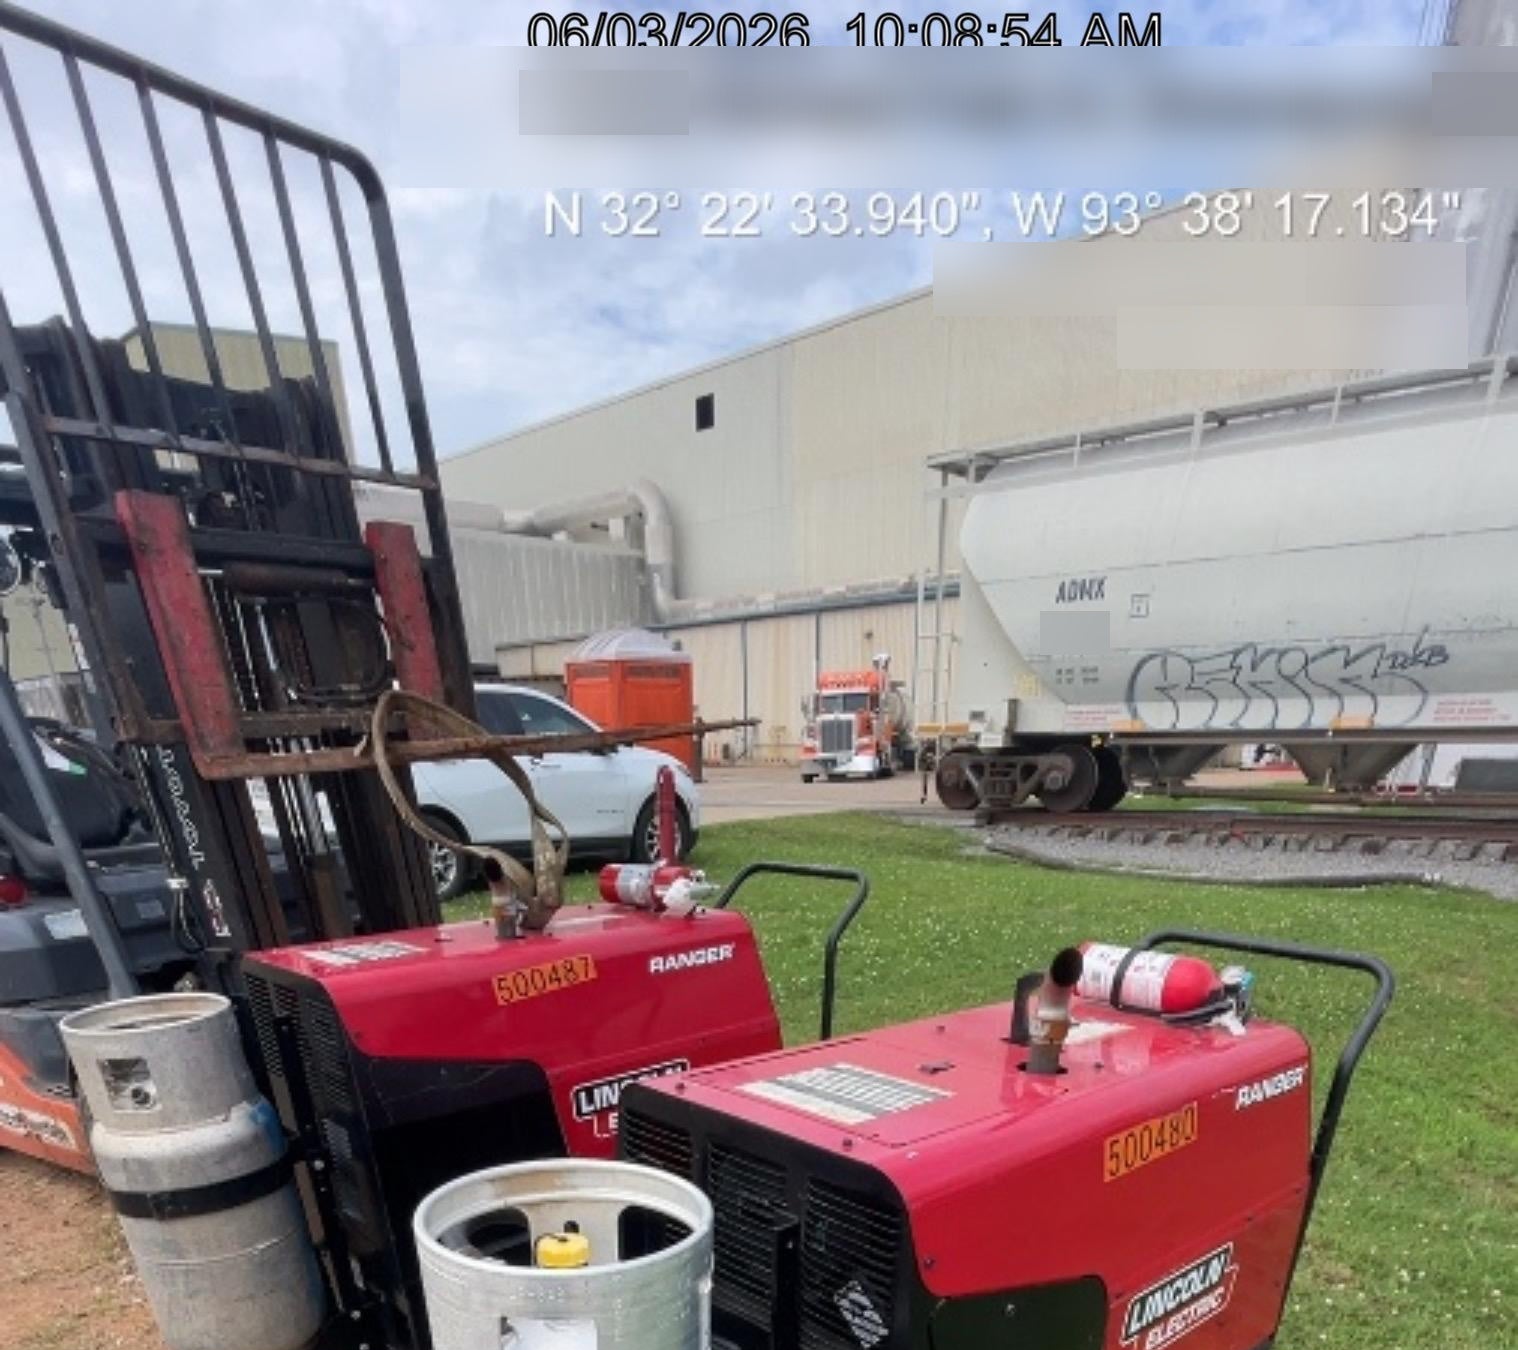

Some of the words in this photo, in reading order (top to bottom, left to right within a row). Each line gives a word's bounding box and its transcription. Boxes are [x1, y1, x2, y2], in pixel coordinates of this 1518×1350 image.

[1055, 576, 1107, 604] ADMX
[498, 956, 591, 1002] 500487
[650, 945, 733, 974] RANGER
[1235, 1067, 1304, 1111] RANGER
[1109, 1106, 1195, 1176] 500480
[1128, 1252, 1226, 1335] LINCOLN
[1145, 1285, 1225, 1350] ELECTRIC
